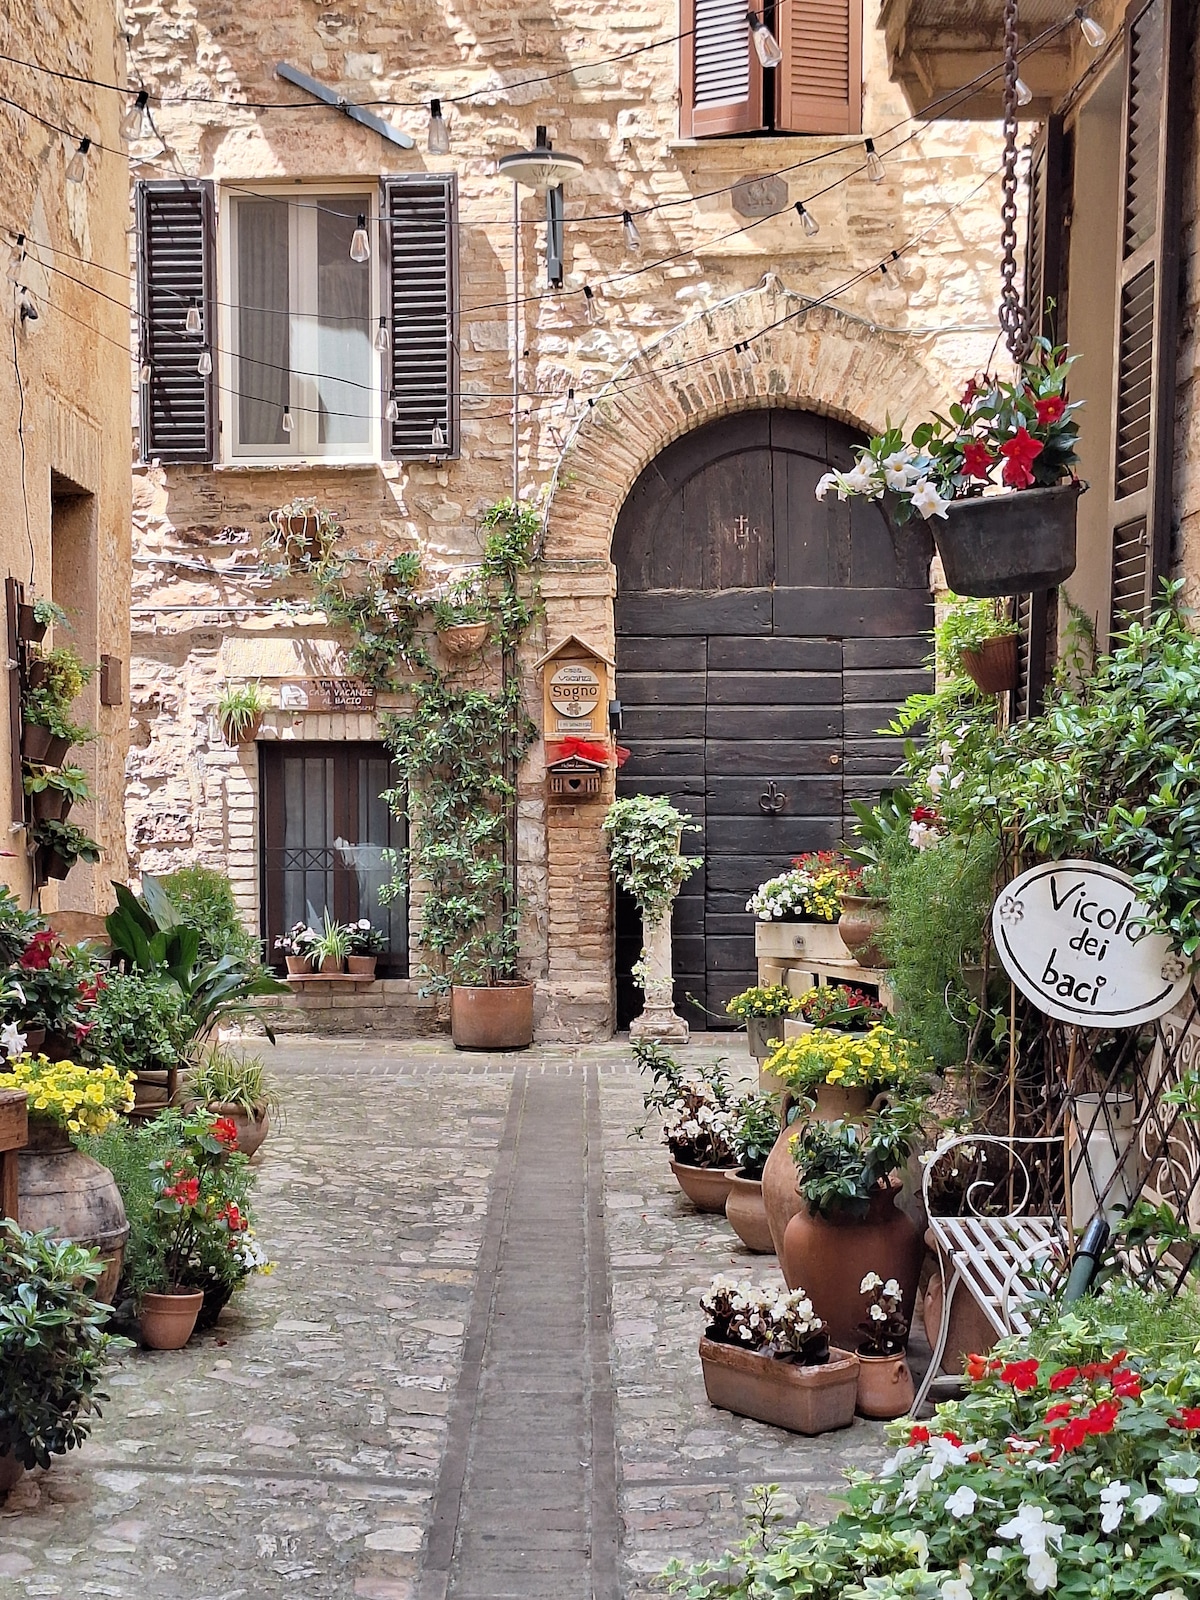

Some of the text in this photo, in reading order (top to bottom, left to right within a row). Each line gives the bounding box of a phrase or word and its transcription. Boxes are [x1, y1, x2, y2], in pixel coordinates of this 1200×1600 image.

[333, 688, 373, 697] VACANZE
[334, 697, 362, 705] BACIO
[552, 685, 598, 702] Sogno
[1050, 875, 1147, 942] Vicolo
[1069, 927, 1110, 961] dei
[1041, 947, 1107, 1006] baci
